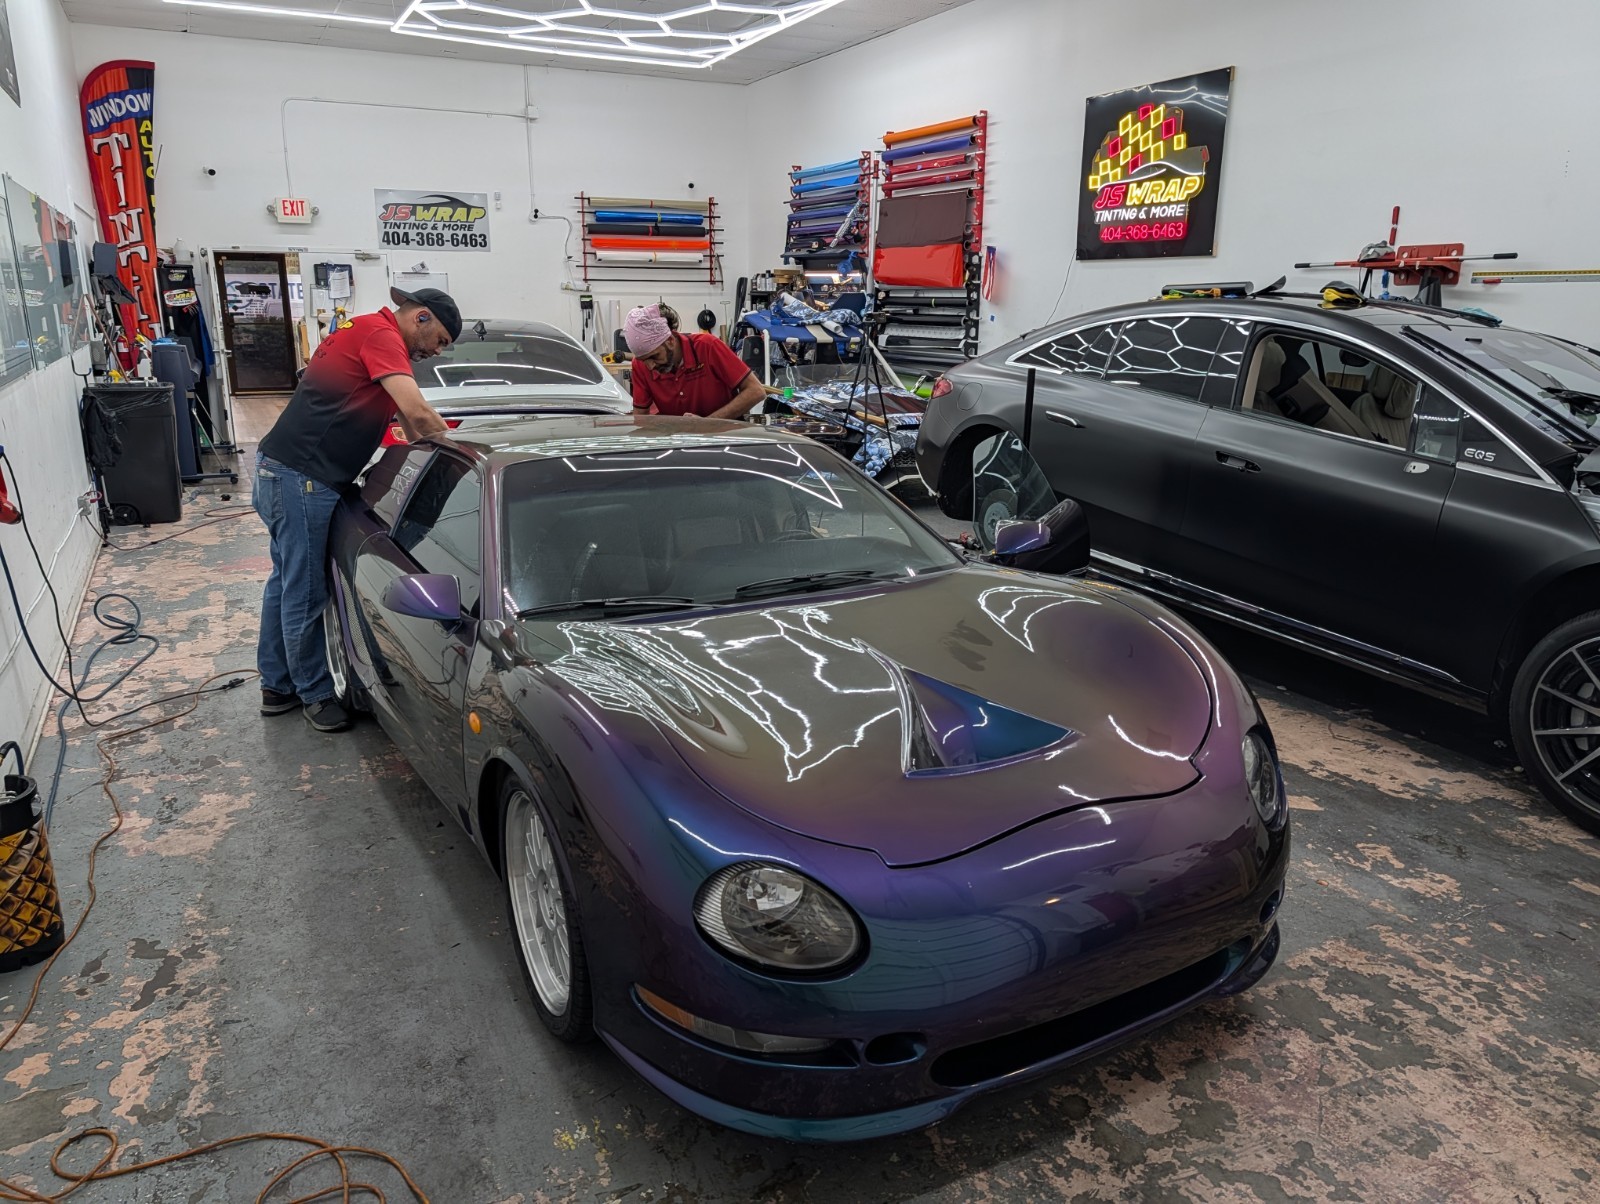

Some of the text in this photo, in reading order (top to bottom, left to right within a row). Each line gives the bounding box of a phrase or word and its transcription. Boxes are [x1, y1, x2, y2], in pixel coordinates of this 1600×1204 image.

[88, 92, 151, 128] WINDOW
[1094, 175, 1200, 209] JS WRAP
[281, 199, 305, 216] EXIT
[380, 205, 486, 222] JS WRAP
[1095, 204, 1186, 222] TINTING & MORE
[383, 221, 475, 232] TINTING & MORE
[1101, 222, 1184, 241] 404-368-6463
[382, 231, 488, 248] 404-368-6463
[1464, 447, 1497, 462] EQS
